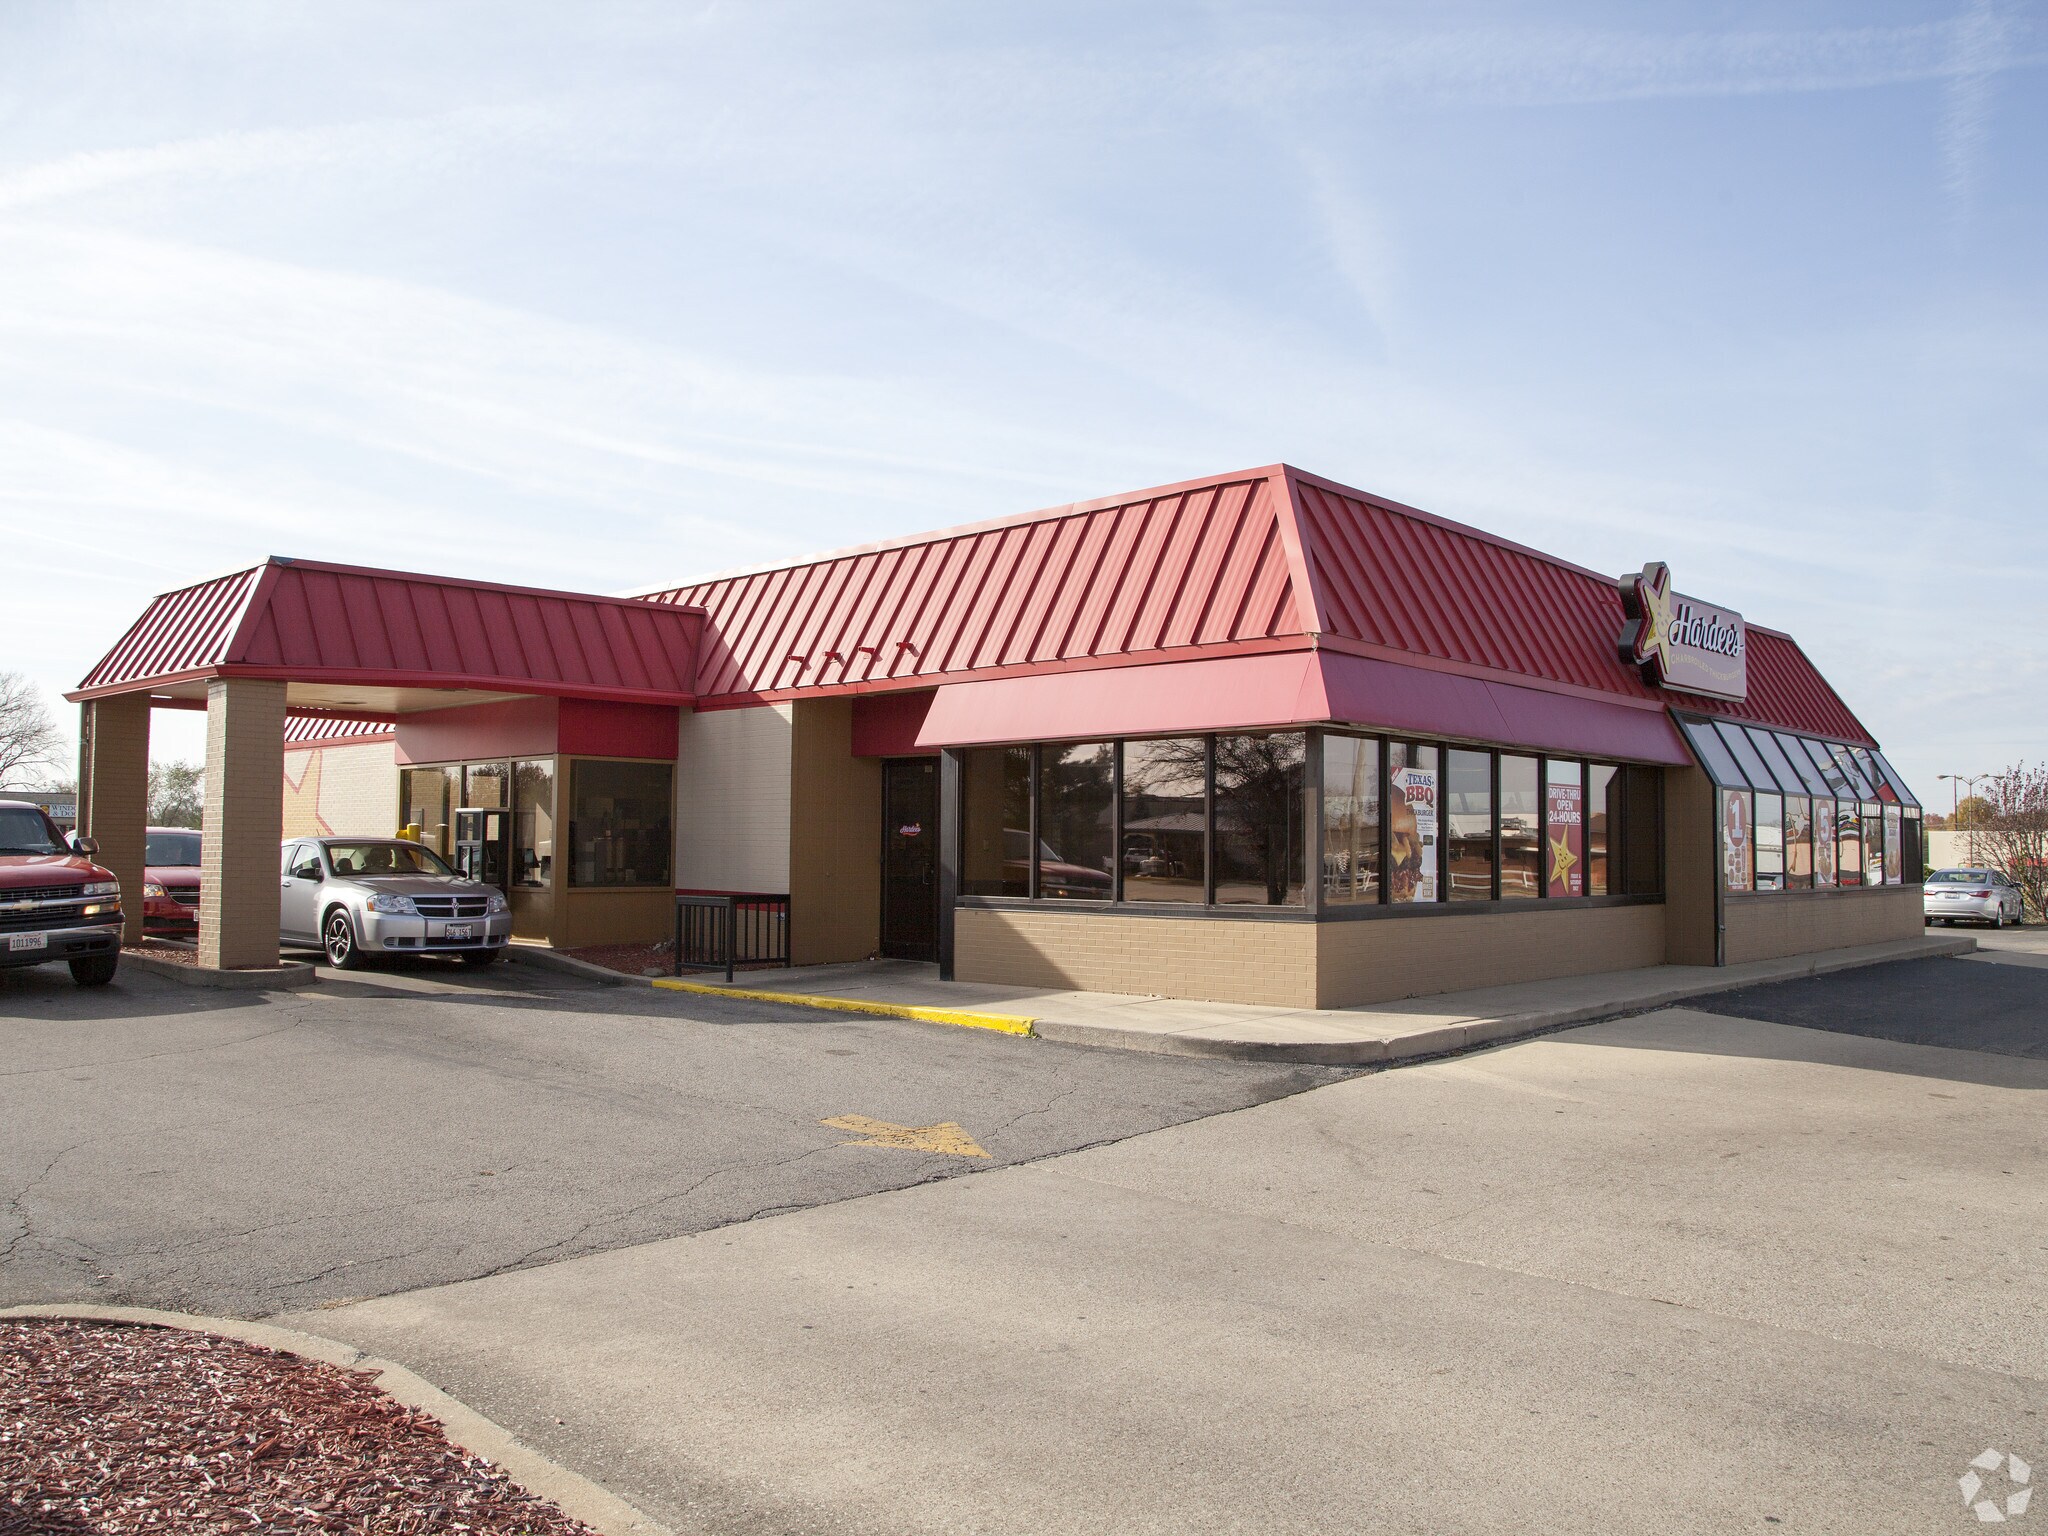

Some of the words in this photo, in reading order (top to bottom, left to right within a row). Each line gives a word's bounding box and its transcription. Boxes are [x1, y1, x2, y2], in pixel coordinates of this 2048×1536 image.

[1668, 604, 1744, 657] Hardee's
[1408, 773, 1432, 787] TEXAS
[1405, 785, 1434, 809] BBQ
[1556, 799, 1574, 811] OPEN
[1549, 810, 1581, 824] 24-HOURS
[12, 936, 42, 949] 1011996
